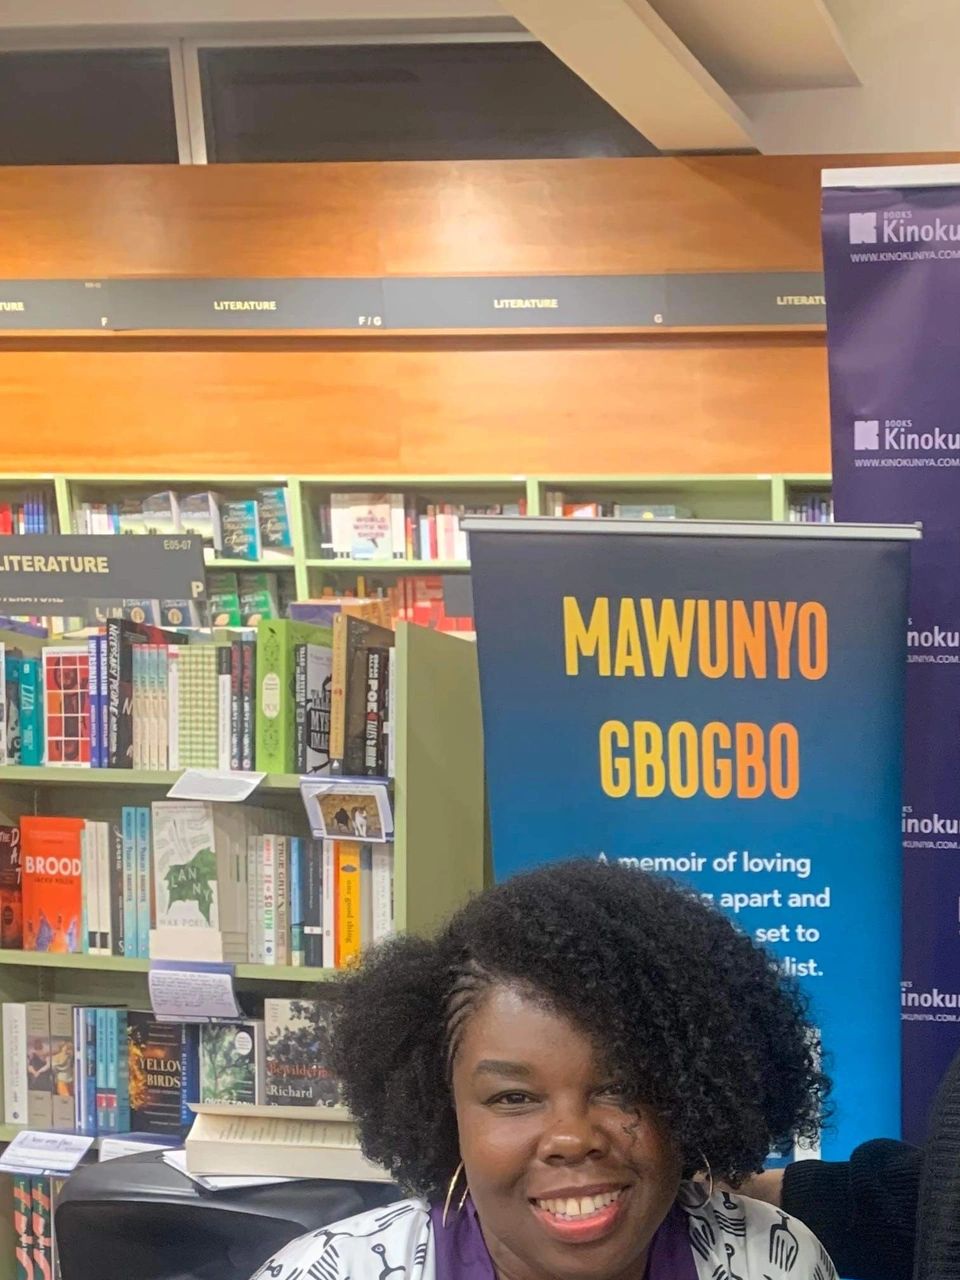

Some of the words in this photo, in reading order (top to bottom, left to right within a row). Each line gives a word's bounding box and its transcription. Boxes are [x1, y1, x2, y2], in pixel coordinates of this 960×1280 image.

[883, 211, 912, 219] BOOKS
[213, 301, 277, 311] LITERATURE
[493, 299, 558, 308] LITERATURE
[884, 420, 912, 428] BOOKS
[191, 581, 204, 598] P
[563, 596, 828, 680] MAWUNYO
[367, 679, 379, 713] POE
[599, 720, 799, 799] GBOGBO
[25, 856, 81, 876] BROOD
[617, 852, 706, 872] memoir
[712, 851, 738, 872] of
[743, 851, 811, 878] loving
[720, 889, 782, 913] apart
[787, 887, 831, 908] and
[755, 925, 790, 942] set
[795, 925, 820, 942] to
[147, 1073, 181, 1088] BIRDS
[270, 1085, 313, 1098] Richard
